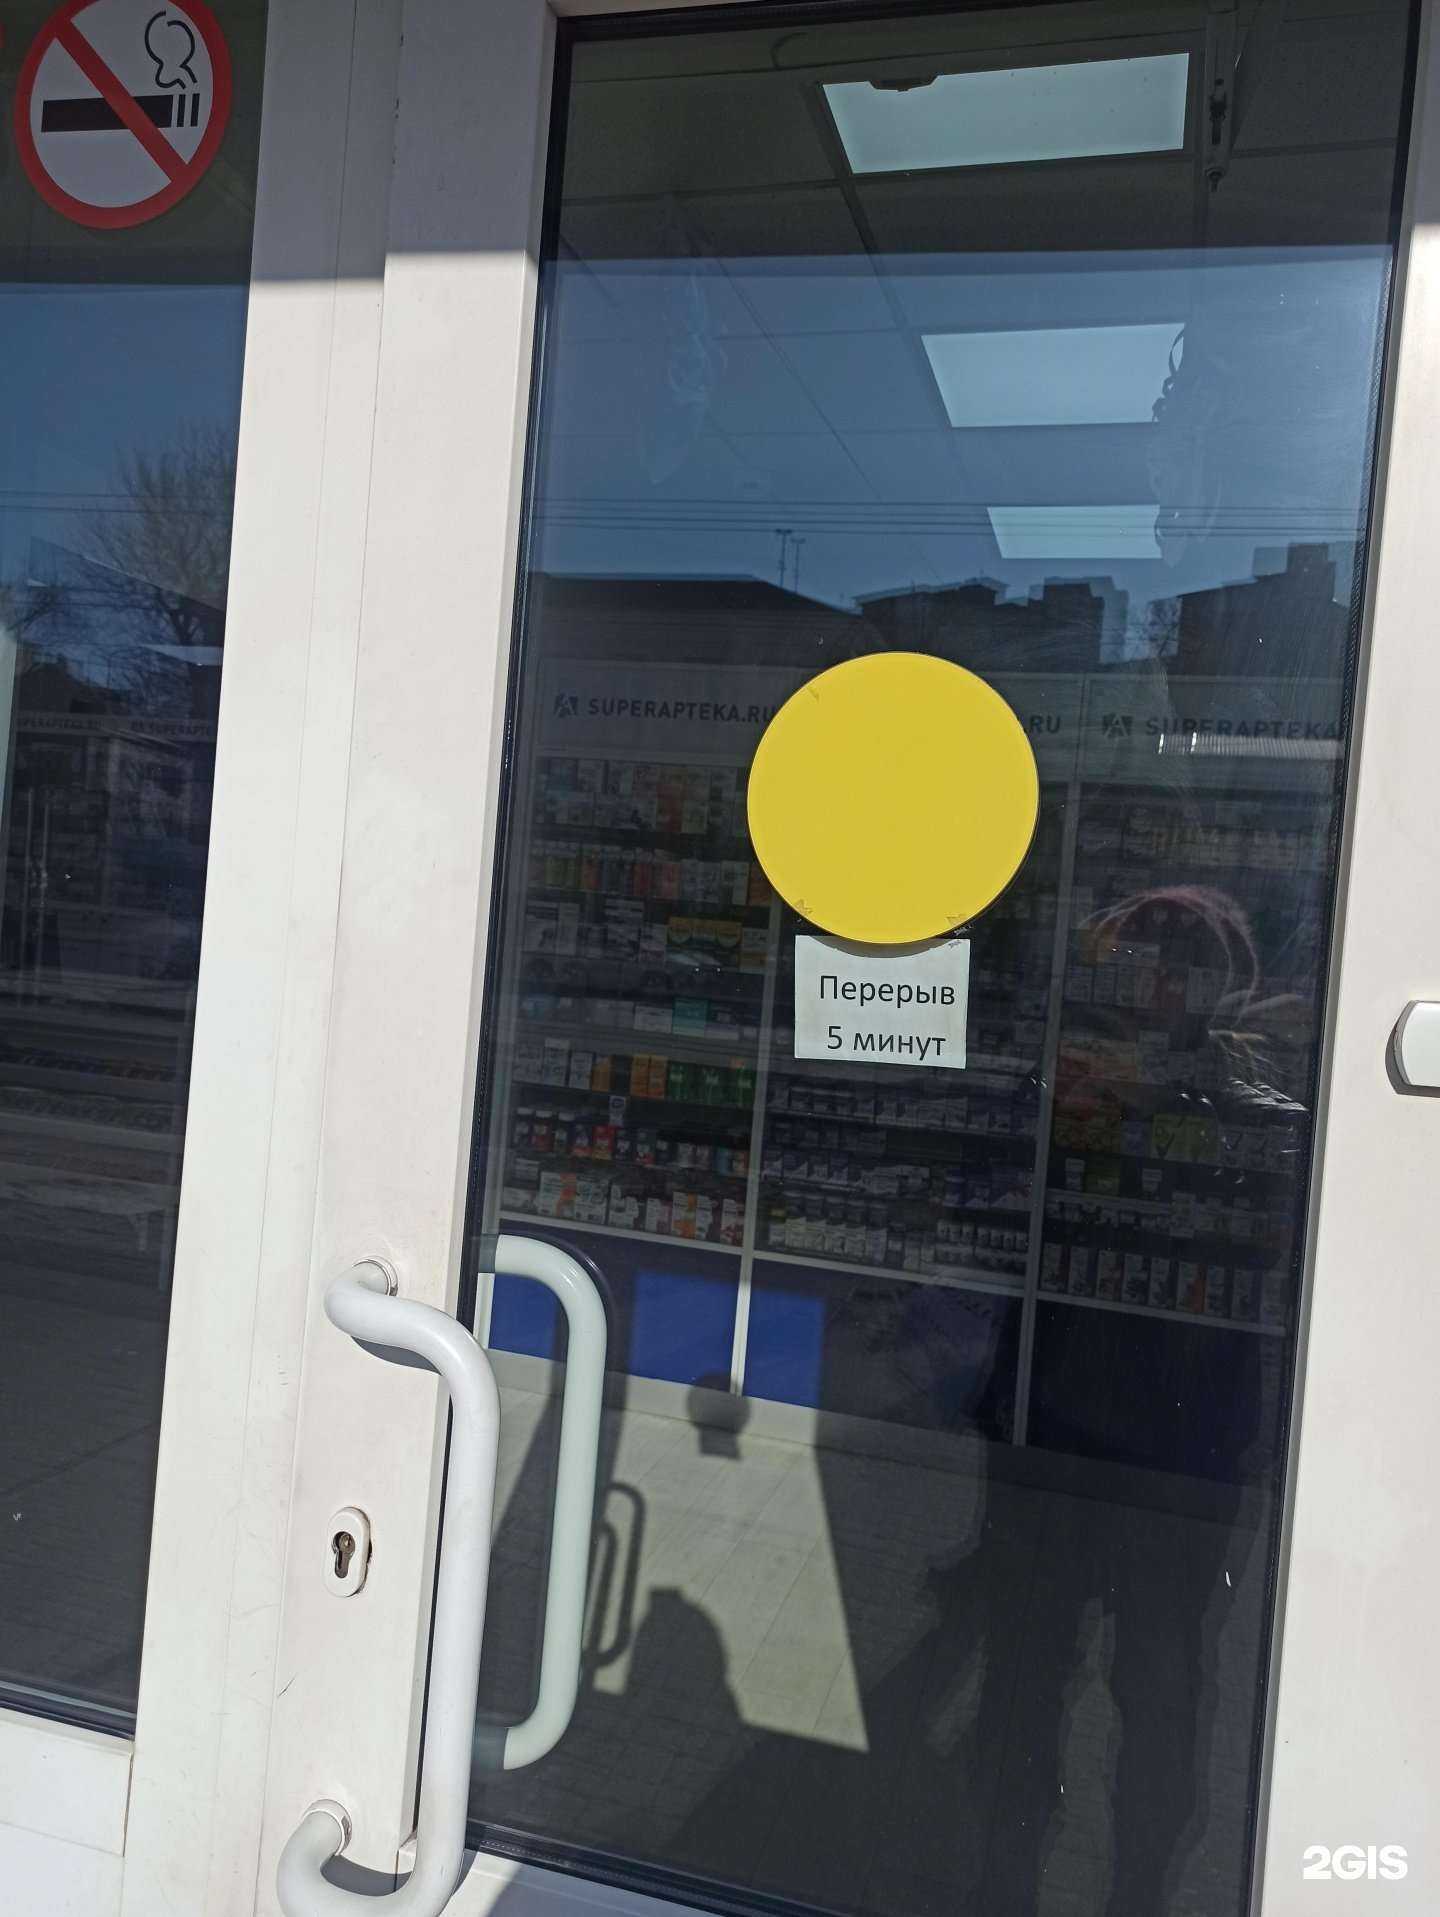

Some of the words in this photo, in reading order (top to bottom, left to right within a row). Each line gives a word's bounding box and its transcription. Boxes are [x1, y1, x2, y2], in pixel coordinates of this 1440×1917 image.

[819, 975, 956, 1009] Перерыв
[827, 1025, 843, 1050] 5
[853, 1032, 947, 1061] минут
